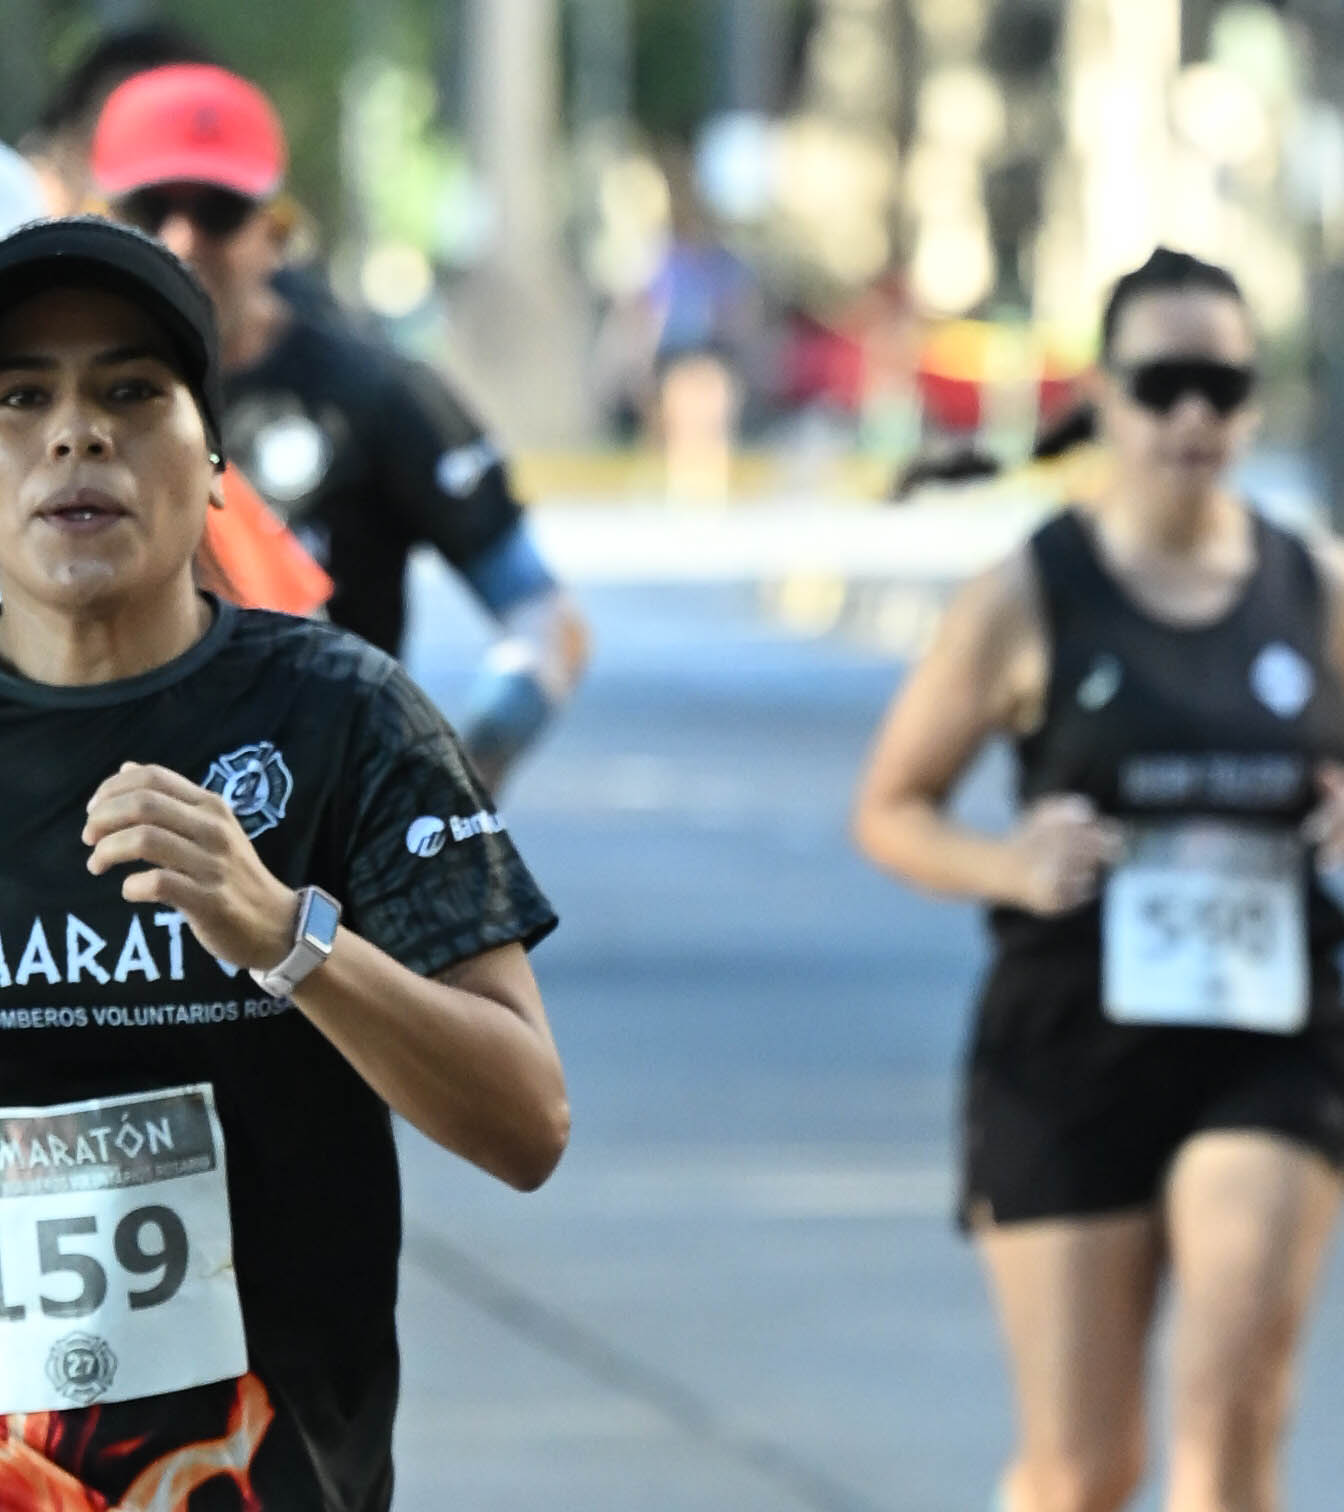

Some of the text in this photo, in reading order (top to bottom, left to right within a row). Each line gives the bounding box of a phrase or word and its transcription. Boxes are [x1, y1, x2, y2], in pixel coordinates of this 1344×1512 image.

[0, 1006, 88, 1031] MBEROS
[92, 1000, 239, 1027] VOLUNTARIOS
[66, 1352, 95, 1378] 27
